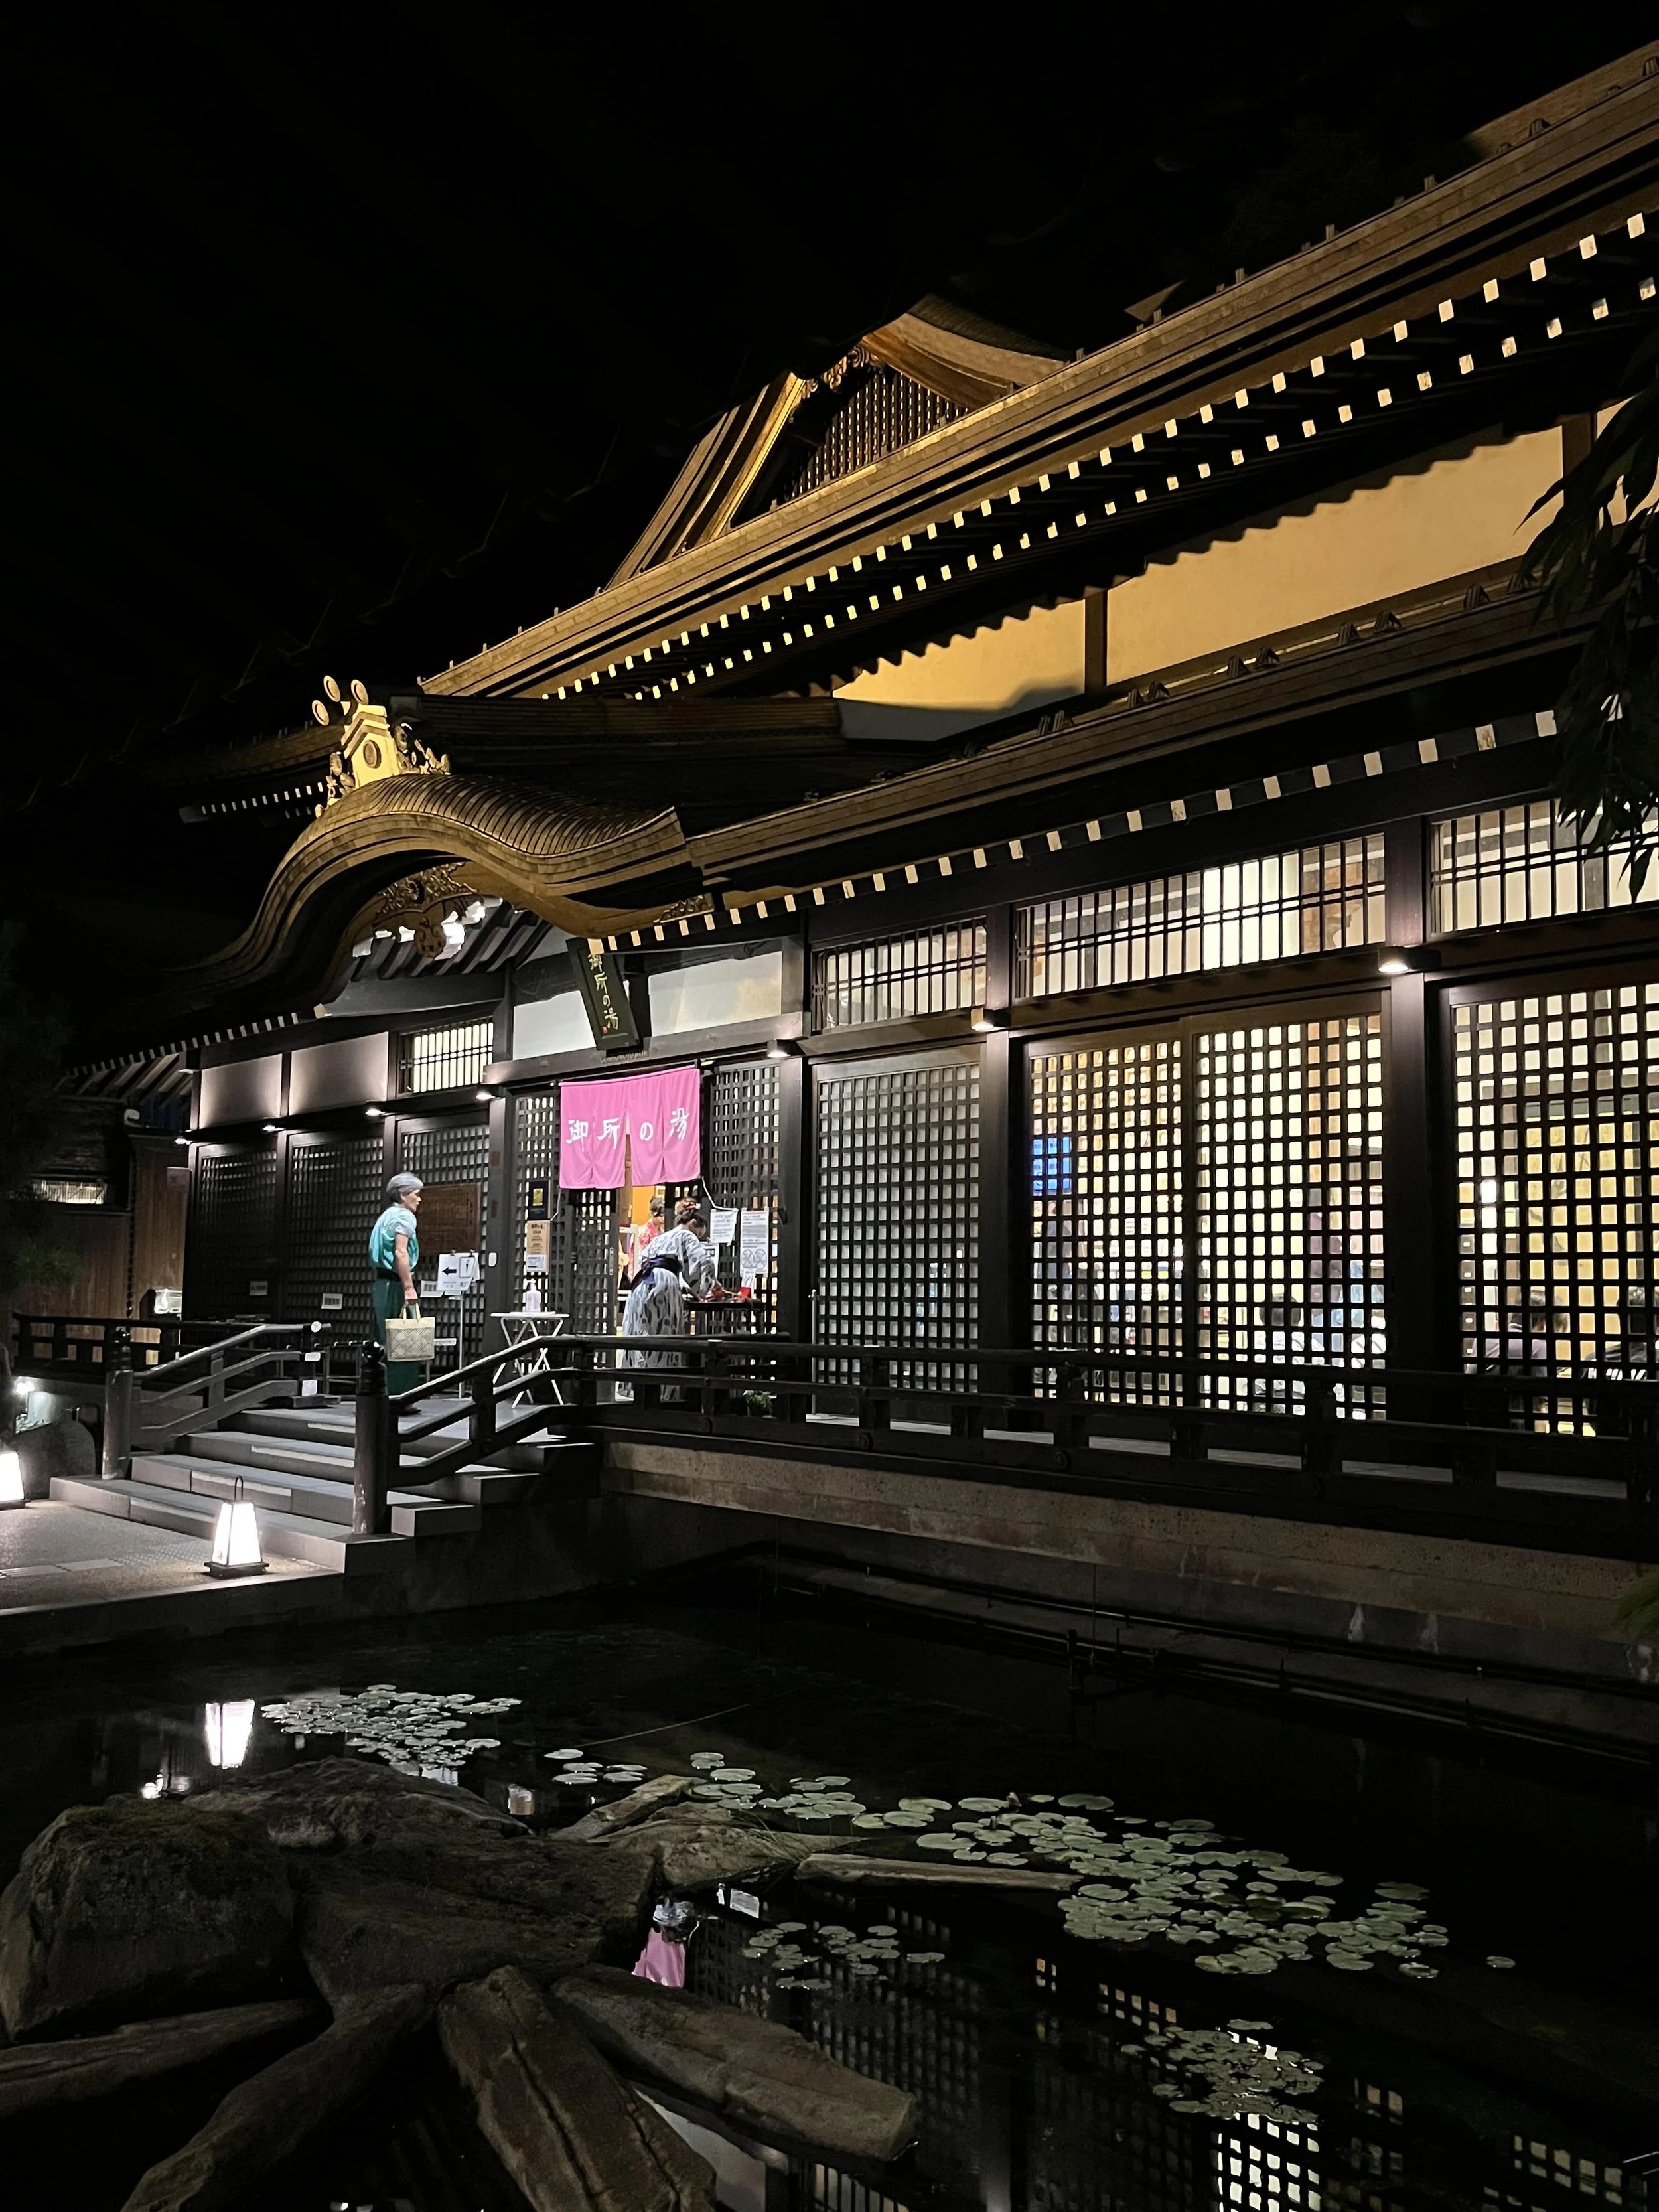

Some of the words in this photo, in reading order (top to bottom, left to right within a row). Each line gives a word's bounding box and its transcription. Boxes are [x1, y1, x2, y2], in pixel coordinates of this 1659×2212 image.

[588, 954, 618, 1030] 御所の湯
[565, 1108, 689, 1152] 御所の湯
